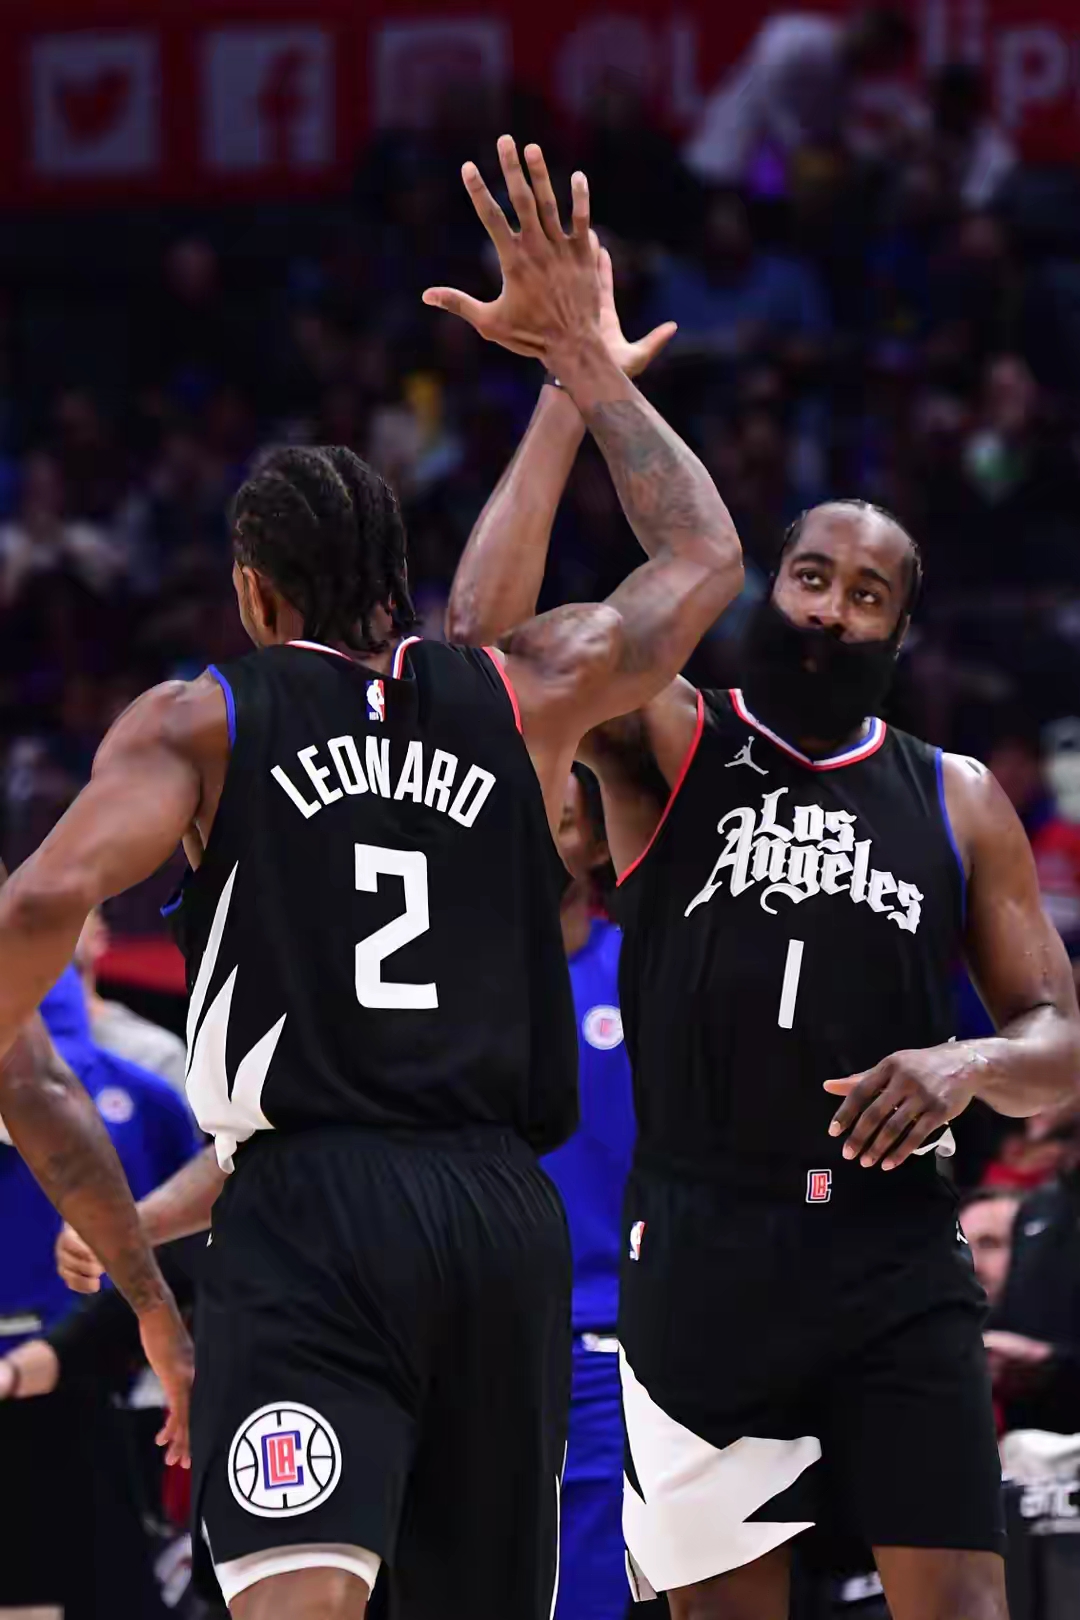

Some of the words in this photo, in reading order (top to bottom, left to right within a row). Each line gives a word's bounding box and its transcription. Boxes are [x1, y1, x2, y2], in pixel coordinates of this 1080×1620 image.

[270, 734, 497, 828] LEONARD
[753, 786, 857, 853] Los
[684, 806, 924, 934] Angeles
[354, 842, 439, 1010] 2
[777, 938, 805, 1030] 1
